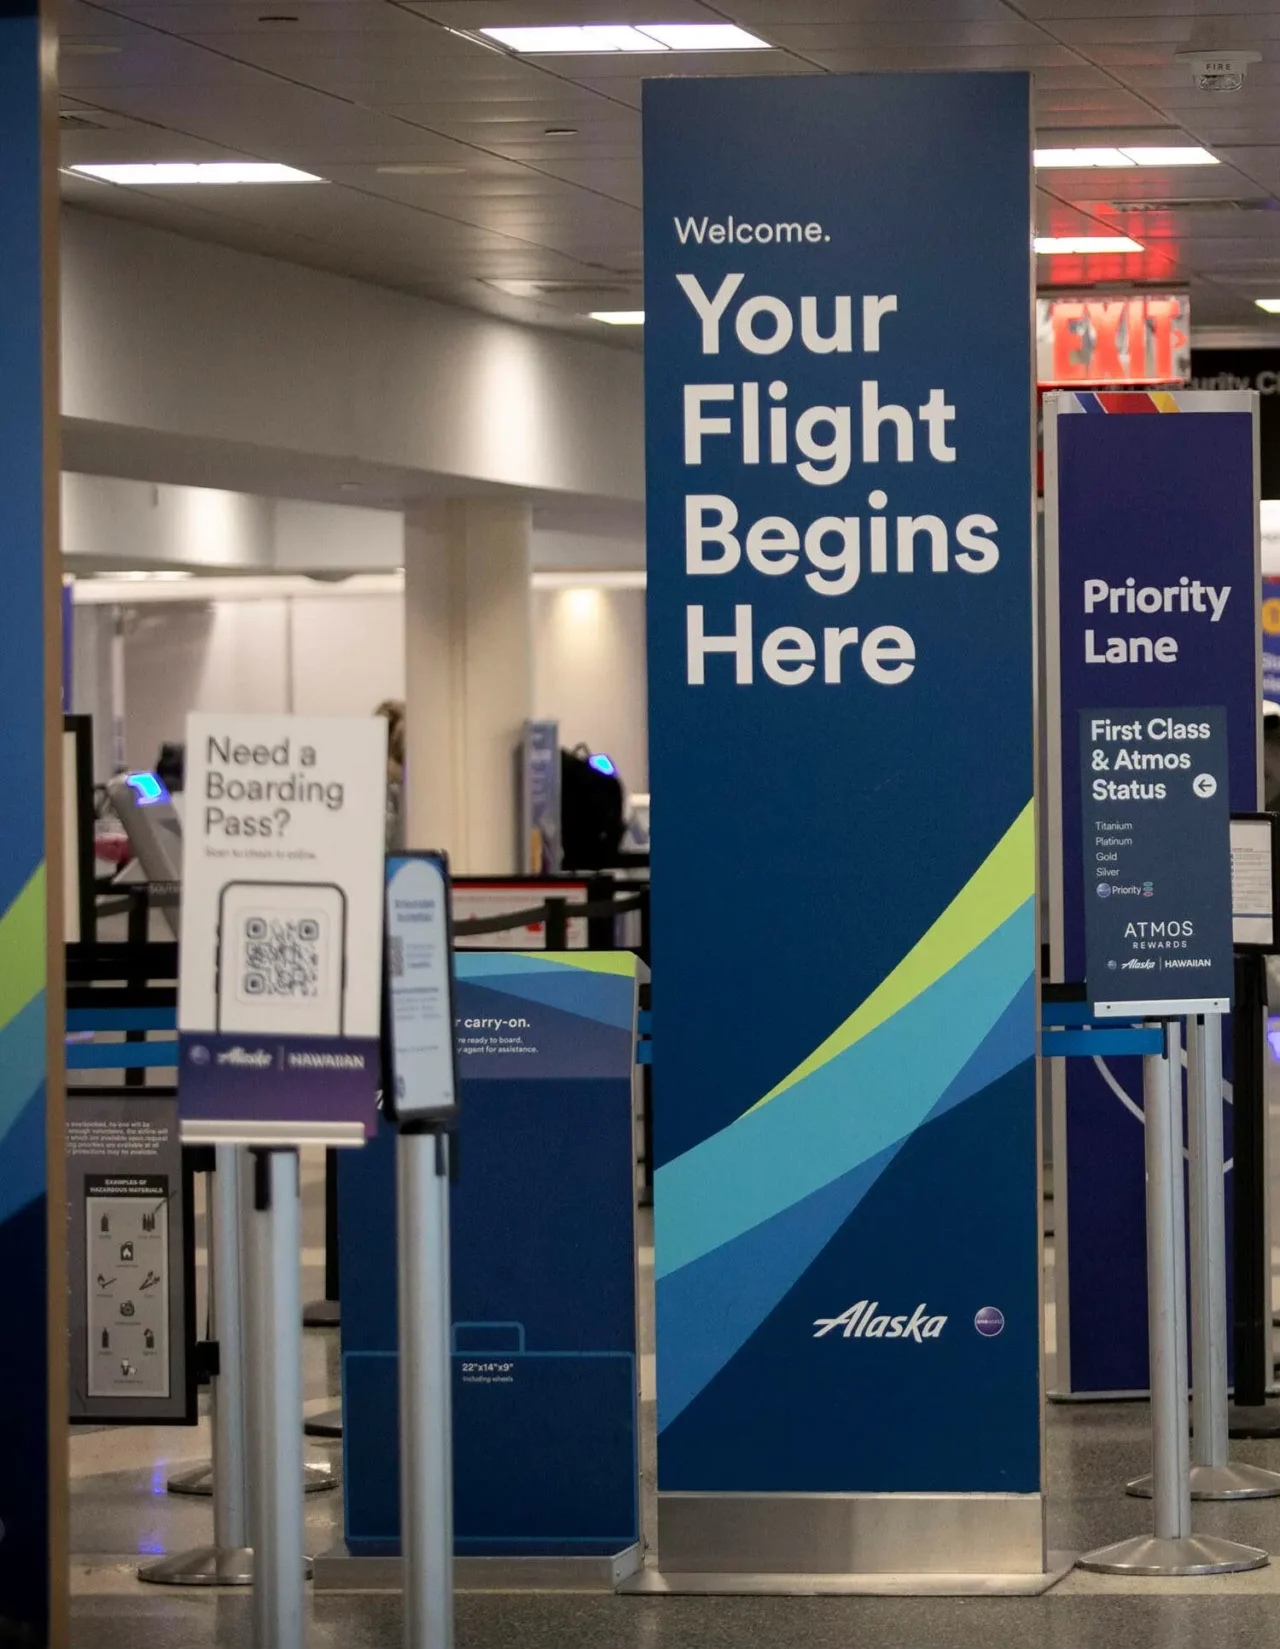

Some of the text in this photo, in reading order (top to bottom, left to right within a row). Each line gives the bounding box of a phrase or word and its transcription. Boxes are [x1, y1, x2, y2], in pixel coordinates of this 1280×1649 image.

[1205, 63, 1232, 71] FIRE
[674, 216, 832, 245] Welcome.
[676, 273, 898, 355] Your
[1051, 299, 1181, 381] EXIT
[683, 380, 957, 486] Flight
[685, 489, 1001, 596] Begins
[1083, 576, 1232, 622] Priority
[686, 603, 917, 685] Here
[1084, 629, 1179, 663] Lane
[1091, 718, 1211, 741] First Class
[206, 734, 317, 767] Need a
[1091, 748, 1192, 771] & Atmos
[205, 770, 345, 812] Boarding
[1092, 778, 1167, 801] Status
[204, 805, 292, 838] Pass?
[1095, 820, 1133, 831] Titanium
[1095, 836, 1133, 847] Platinum
[1095, 852, 1118, 862] Gold
[1096, 868, 1120, 877] Silver
[1111, 885, 1142, 896] Priority
[1123, 920, 1195, 938] ATMOS
[1132, 940, 1188, 950] REWARDS
[1121, 958, 1212, 970] Alaska HAWAIIAN
[463, 1018, 531, 1031] carry-on.
[812, 1299, 949, 1343] Alaska
